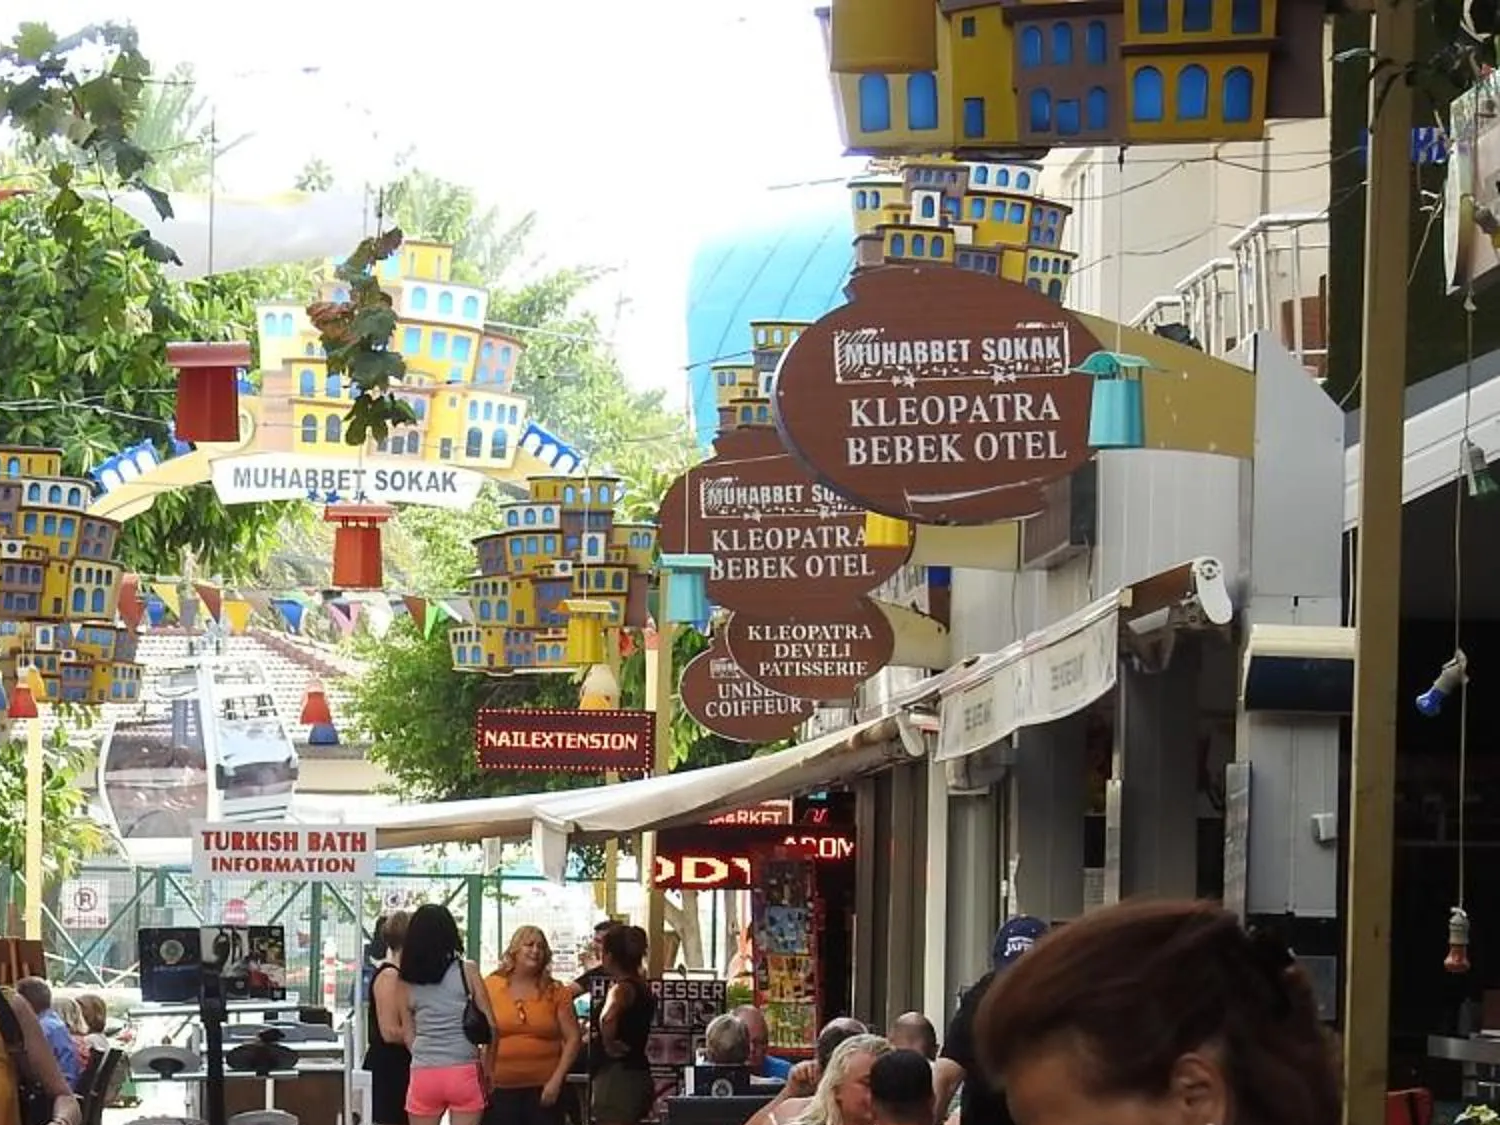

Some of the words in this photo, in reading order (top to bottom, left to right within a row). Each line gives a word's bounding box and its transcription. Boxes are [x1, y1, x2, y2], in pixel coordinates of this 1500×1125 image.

[846, 338, 971, 366] MUHABBET
[981, 336, 1060, 361] SOKAK
[849, 393, 1061, 428] KLEOPATRA
[846, 433, 965, 466] BEBEK
[974, 431, 1067, 461] OTEL
[233, 467, 367, 491] MUHABBET
[375, 470, 458, 493] SOKAK
[707, 483, 805, 507] MUHABBET
[711, 526, 868, 552] KLEOPATRA
[709, 555, 799, 581] BEBEK
[805, 553, 876, 578] OTEL
[747, 624, 873, 642] KLEOPATRA
[774, 643, 851, 659] DEVELI
[758, 660, 869, 678] PATISSERIE
[704, 697, 804, 719] COIFFEUR
[483, 729, 638, 751] NAILEXTENSION
[201, 831, 299, 852] TURKISH
[307, 831, 367, 853] BATH
[211, 856, 356, 873] INFORMATION
